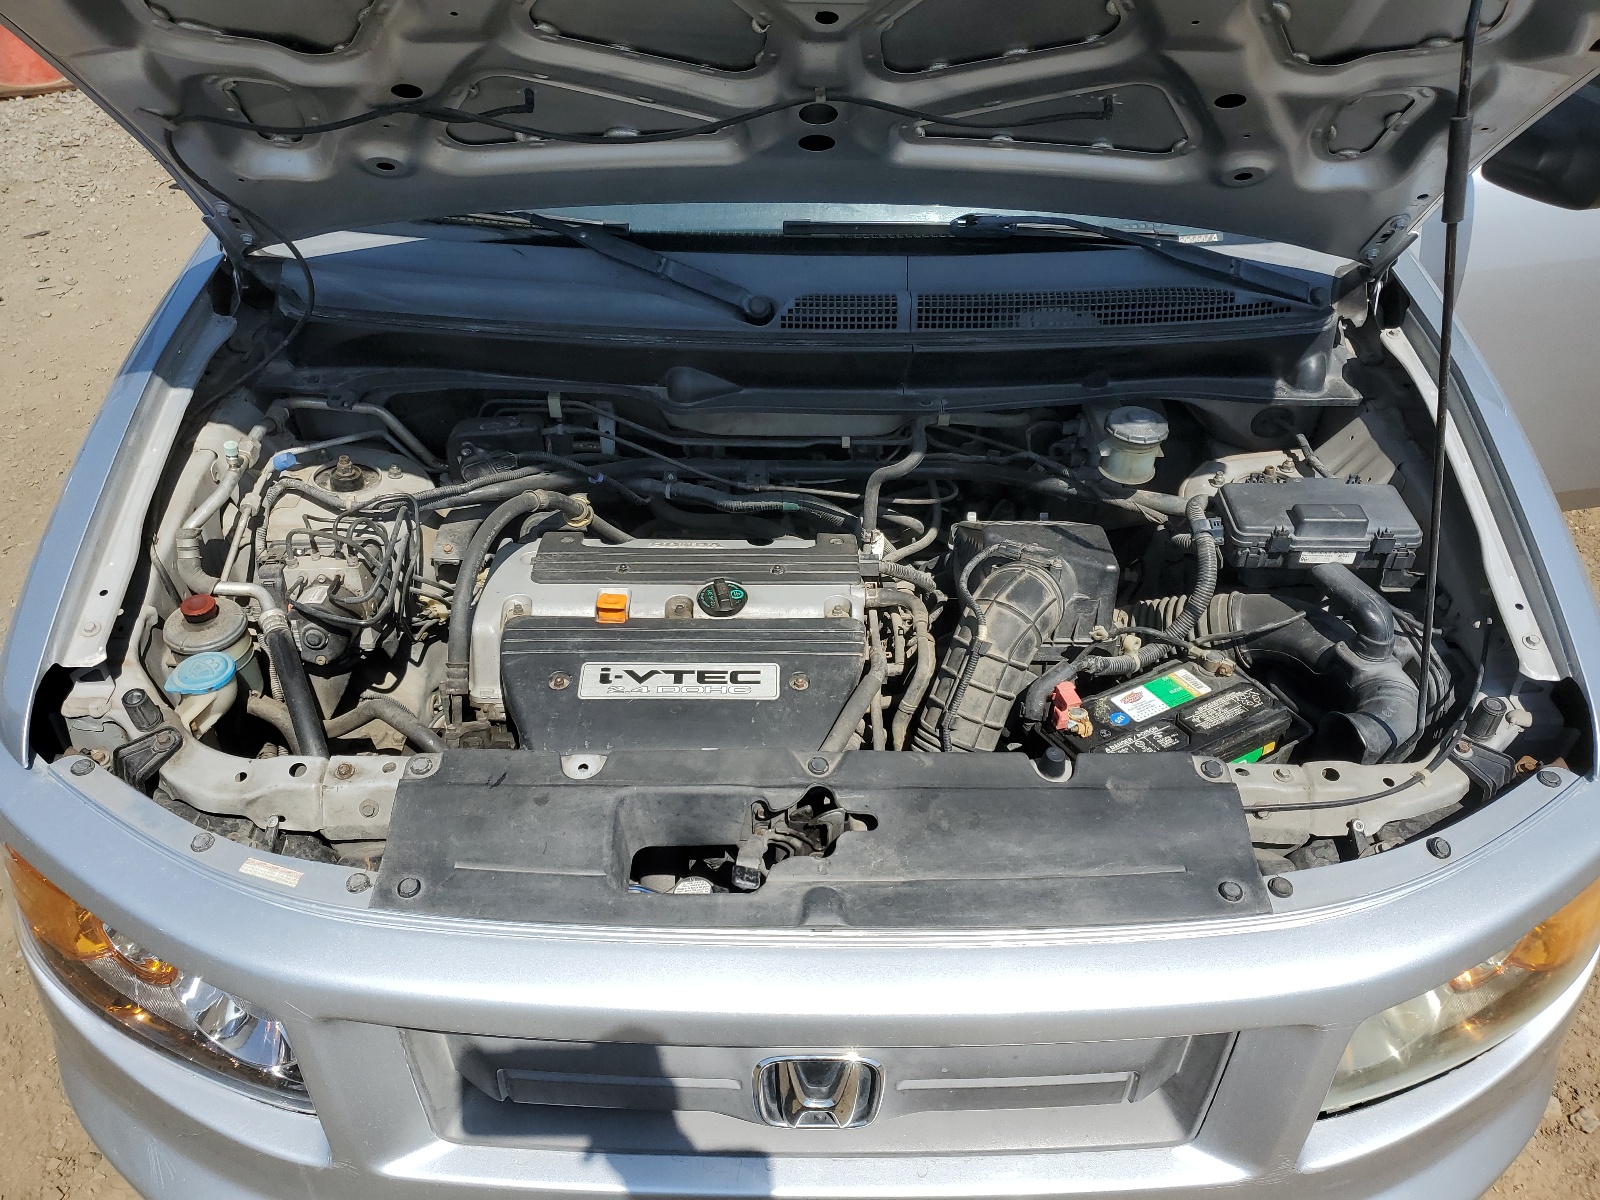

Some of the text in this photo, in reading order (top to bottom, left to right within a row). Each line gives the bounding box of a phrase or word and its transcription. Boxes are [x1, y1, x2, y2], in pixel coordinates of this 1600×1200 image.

[599, 667, 761, 685] i-VTEC
[606, 685, 752, 694] 2.4 DOHC
